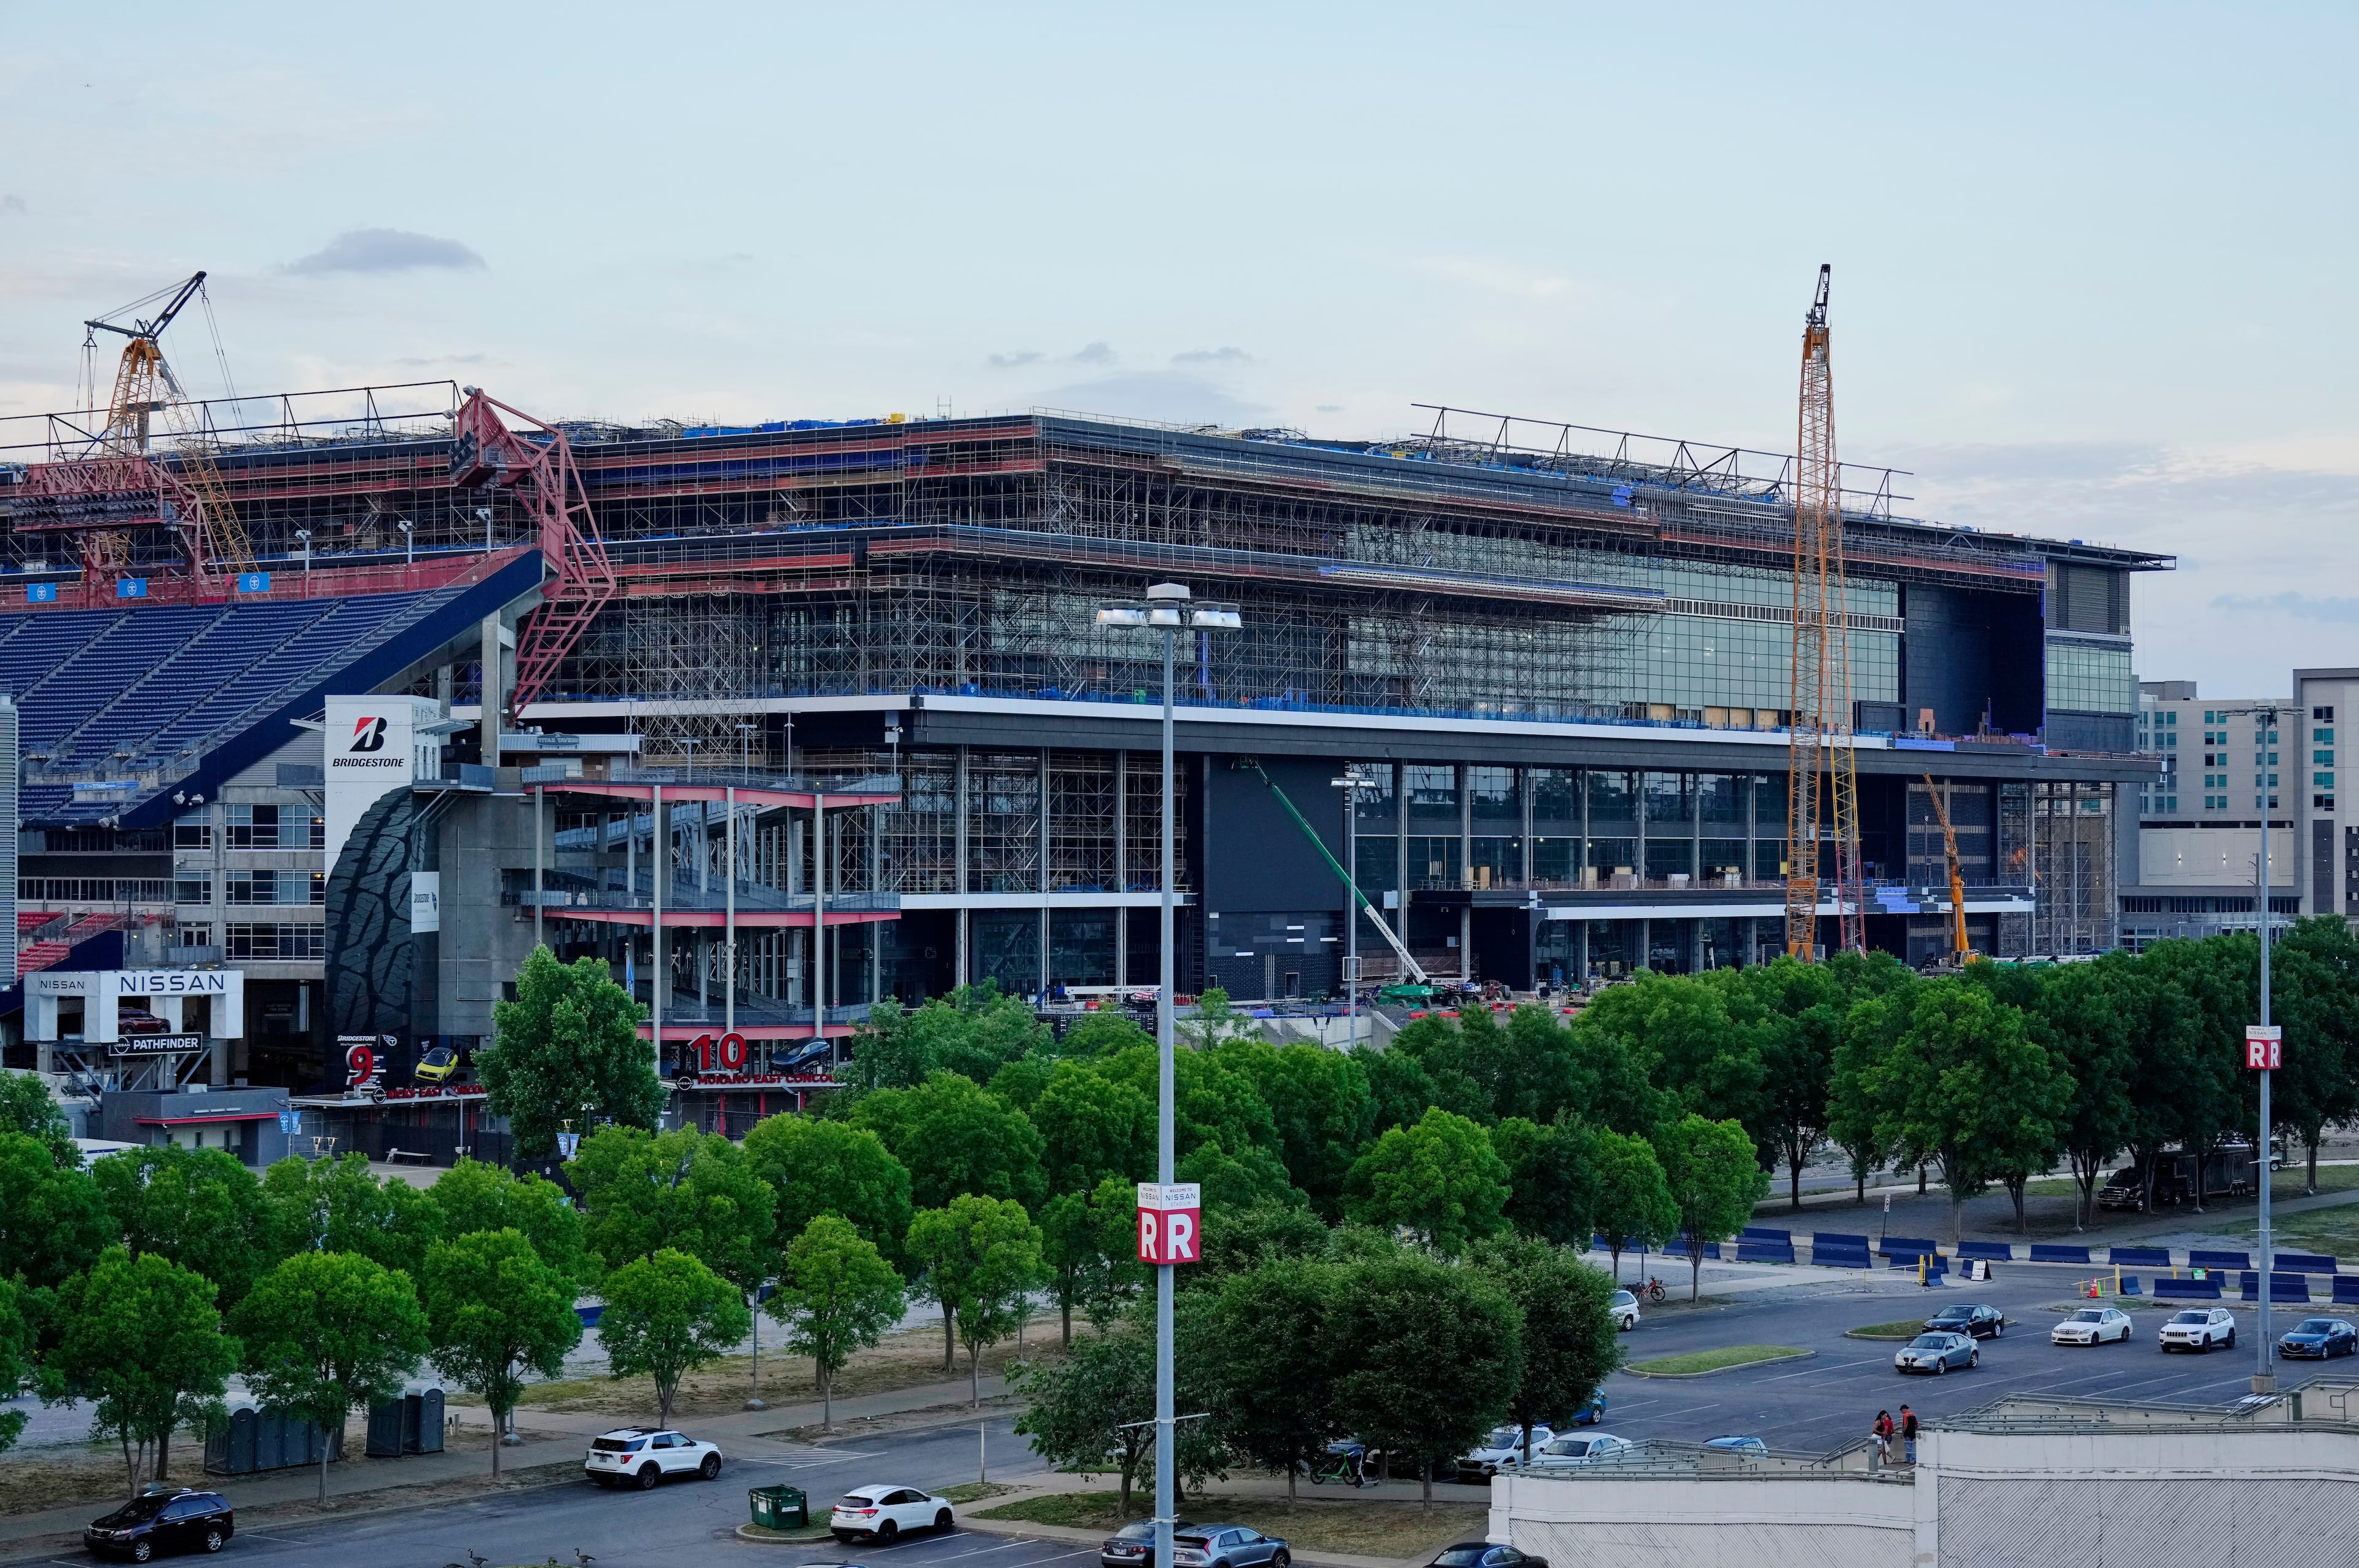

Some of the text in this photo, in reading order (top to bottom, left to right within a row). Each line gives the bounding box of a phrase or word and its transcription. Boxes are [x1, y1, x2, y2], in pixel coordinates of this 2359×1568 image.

[332, 759, 405, 767] BRIDGESTONE
[40, 980, 84, 989] NISSAN
[120, 975, 224, 992] NISSAN
[133, 1038, 198, 1050] PATHFINDER
[687, 1032, 747, 1071] 10
[2250, 1041, 2265, 1067] R
[2270, 1042, 2279, 1067] R
[346, 1044, 374, 1085] 9
[697, 1075, 751, 1085] MURANO
[753, 1074, 782, 1084] EAST
[387, 1088, 416, 1099] KICKS
[419, 1086, 444, 1098] EAST
[1140, 1192, 1159, 1201] NISSAN
[1165, 1193, 1196, 1201] NISSAN
[1141, 1212, 1157, 1260] R
[1167, 1213, 1194, 1260] R
